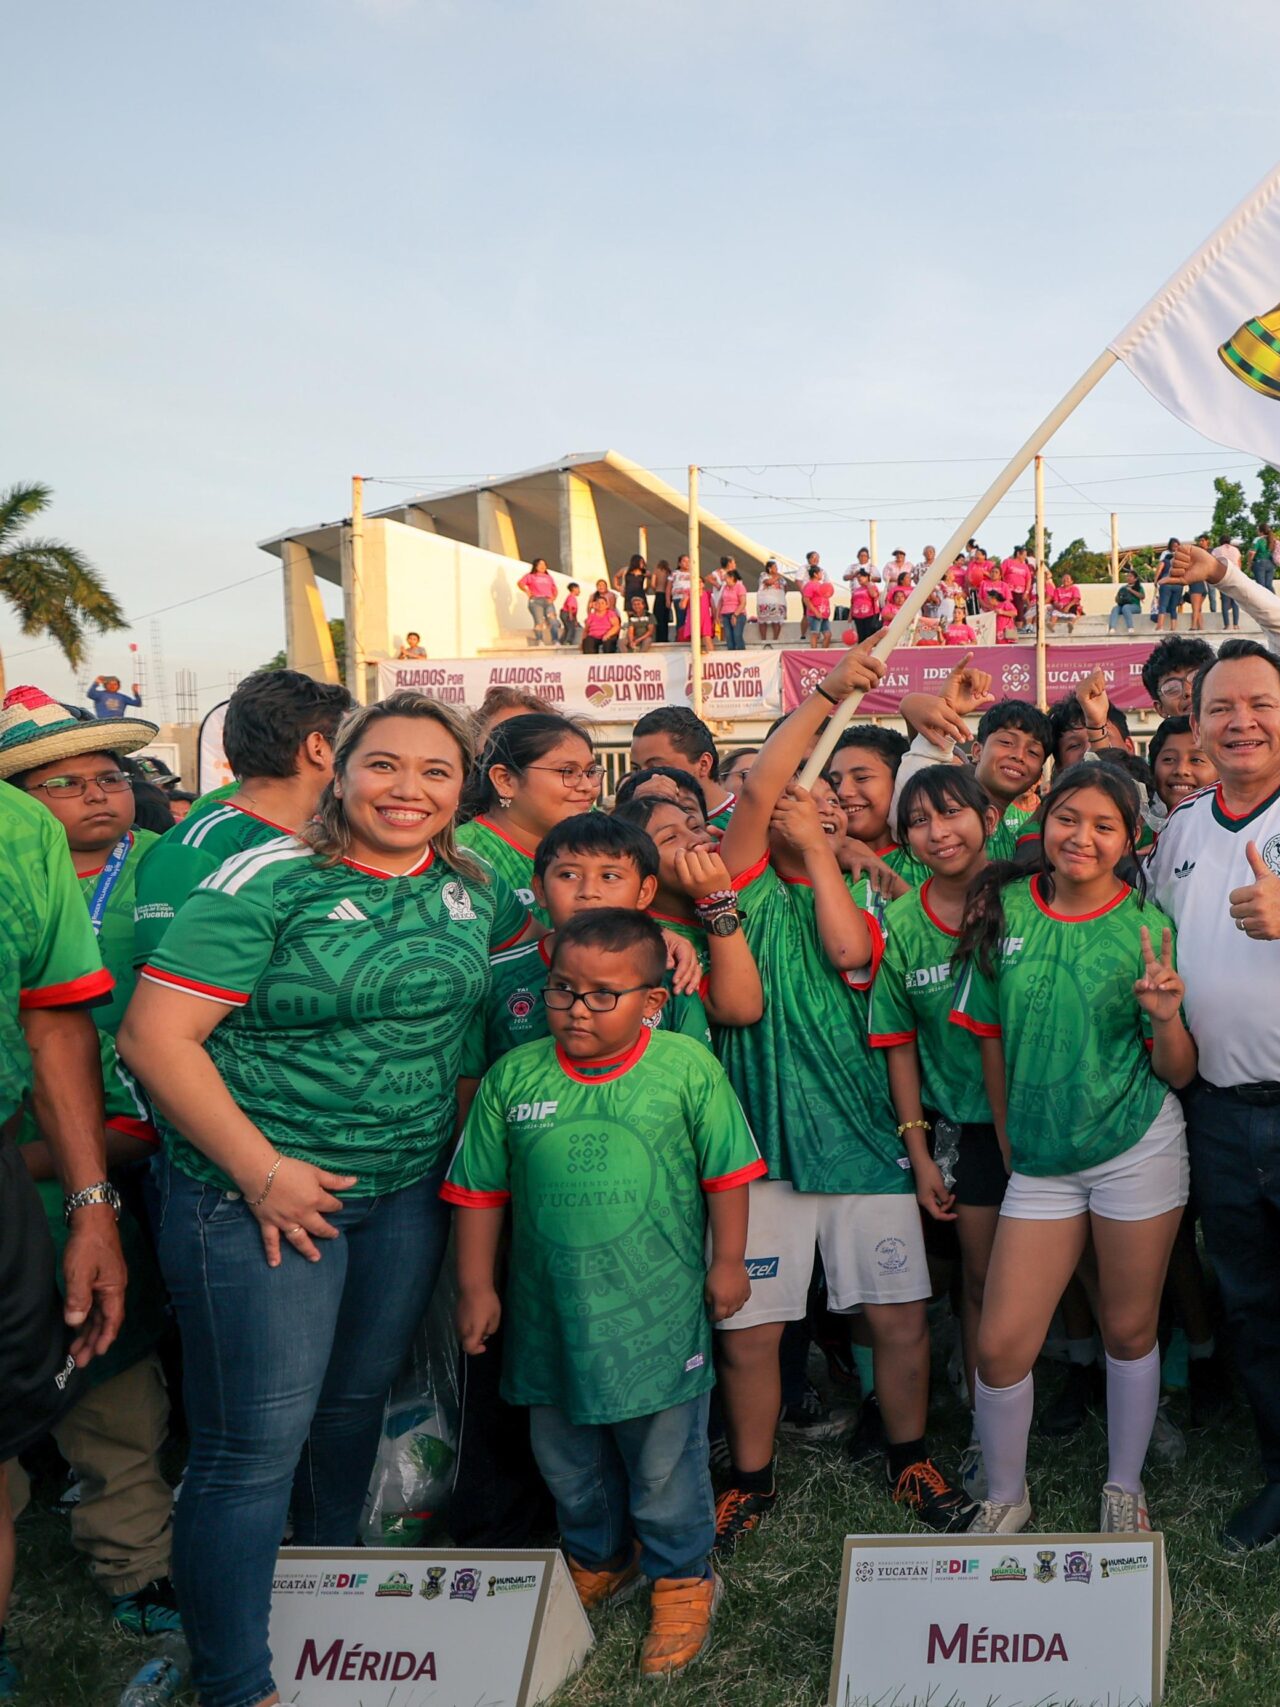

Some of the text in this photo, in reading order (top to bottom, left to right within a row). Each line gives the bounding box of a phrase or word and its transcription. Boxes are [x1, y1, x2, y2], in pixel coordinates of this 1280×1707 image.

[395, 669, 464, 687] ALIADOS POR
[489, 667, 562, 684] ALIADOS POR
[587, 665, 662, 682] ALIADOS POR
[742, 666, 760, 678] POR
[1048, 670, 1115, 683] UCATN
[615, 683, 665, 701] LA VIDA
[713, 680, 763, 698] LA VIDA
[915, 963, 951, 988] DIF
[517, 1100, 559, 1122] DIF
[538, 1187, 638, 1208] YUCATÁN
[878, 1560, 980, 1576] YUCATÁN DIF
[272, 1573, 369, 1589] UCATÁN DIF
